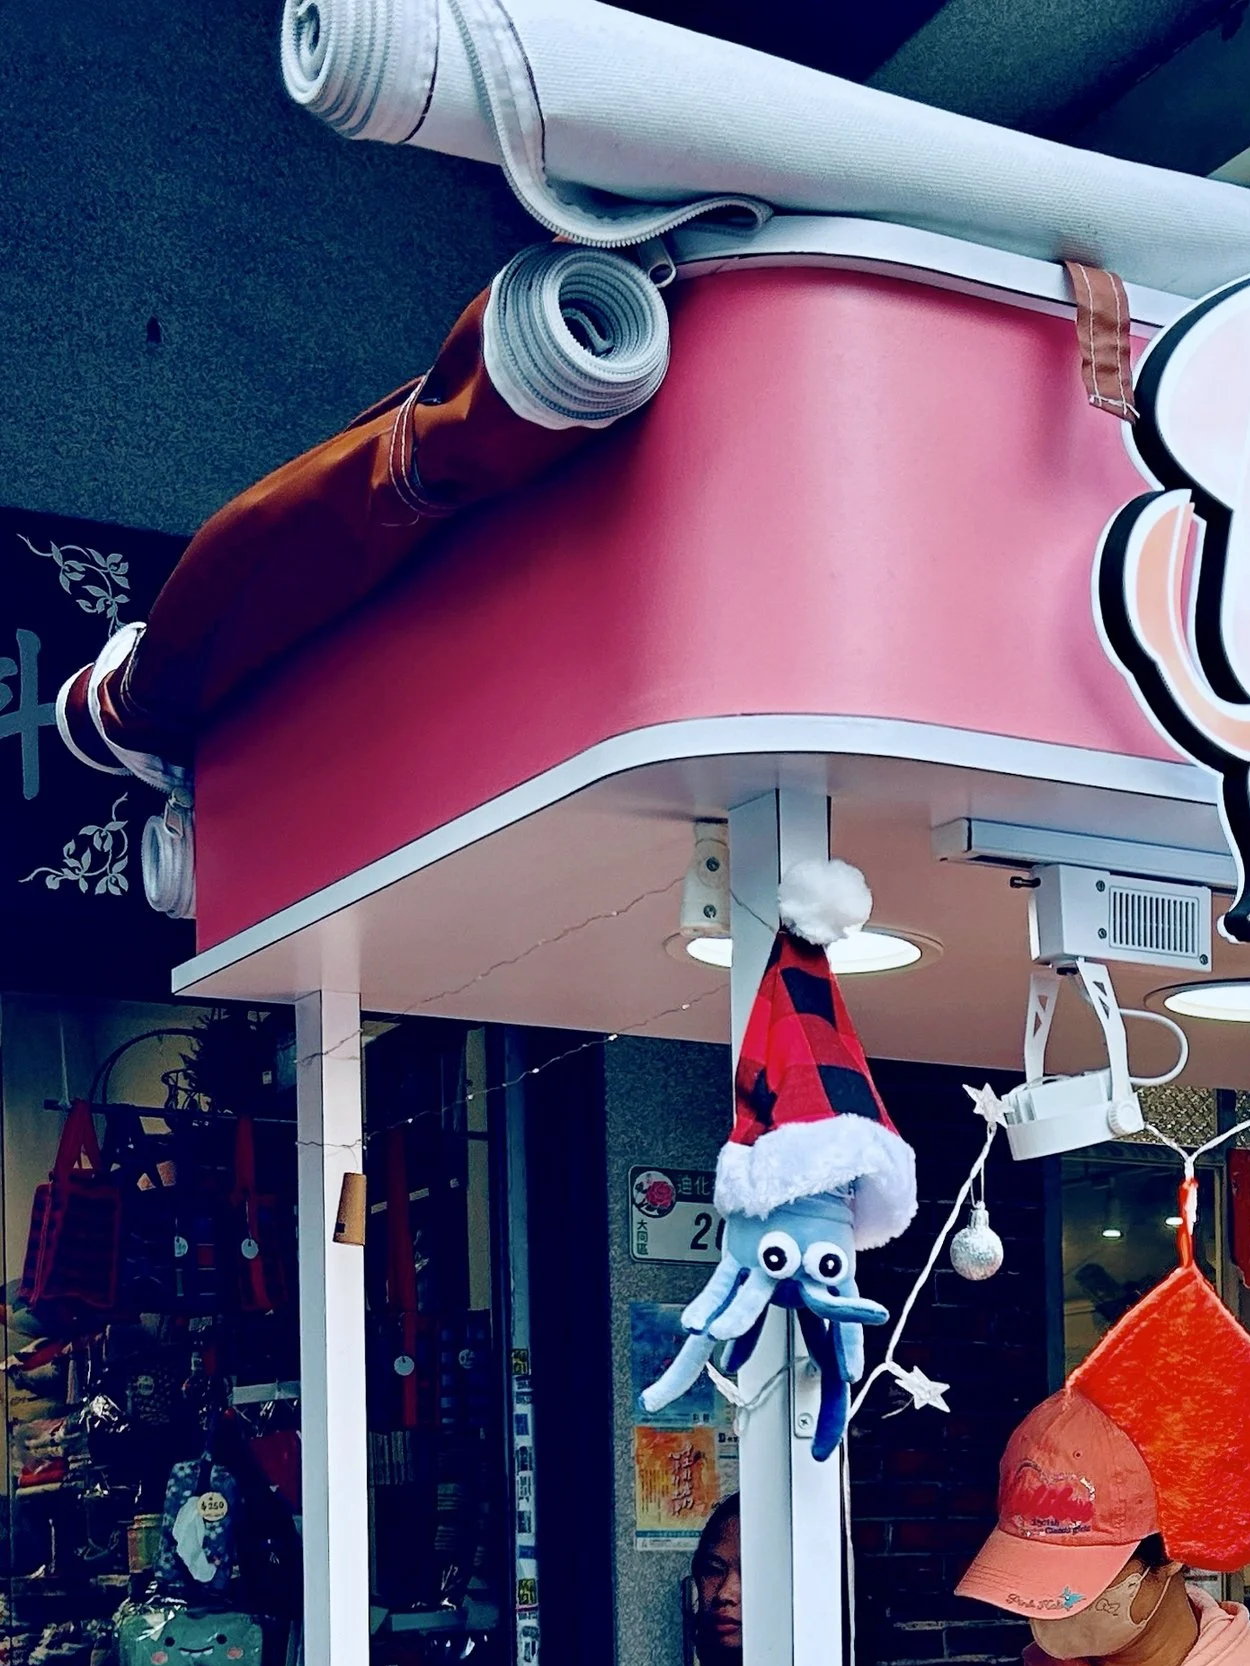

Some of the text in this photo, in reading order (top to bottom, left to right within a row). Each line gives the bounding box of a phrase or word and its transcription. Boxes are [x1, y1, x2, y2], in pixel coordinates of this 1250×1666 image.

[678, 1174, 716, 1196] 迪化
[636, 1219, 649, 1256] 大同區
